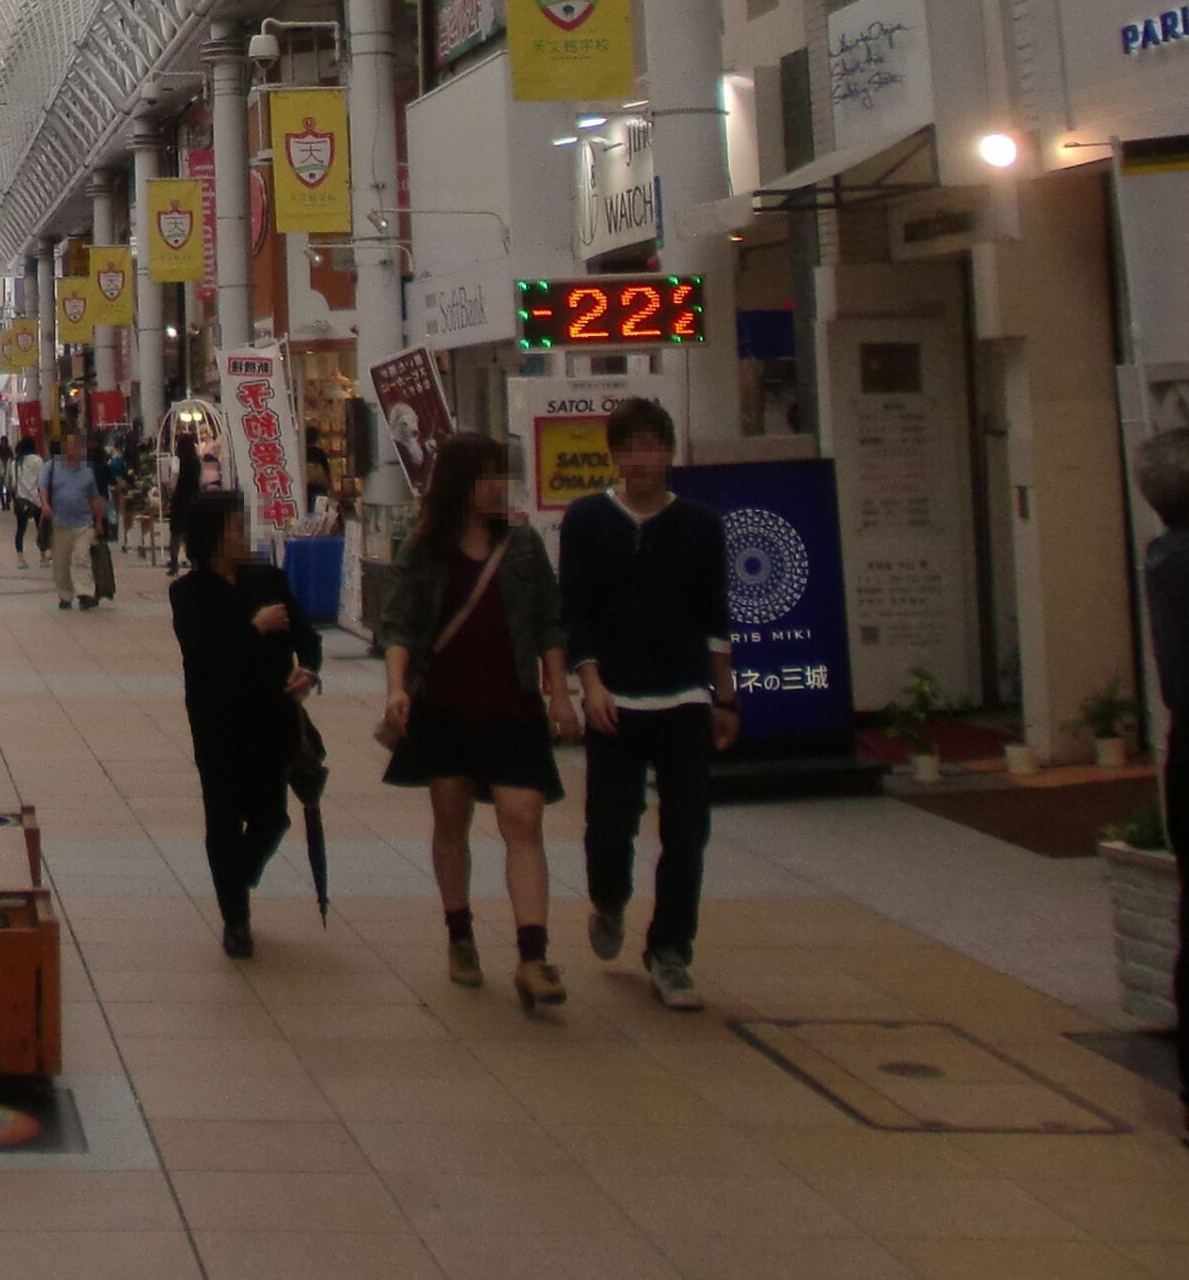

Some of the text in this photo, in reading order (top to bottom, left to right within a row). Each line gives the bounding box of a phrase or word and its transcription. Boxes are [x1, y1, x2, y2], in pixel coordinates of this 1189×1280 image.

[604, 183, 653, 234] WATCH
[439, 283, 488, 334] SoftBank
[547, 399, 595, 413] SATOL
[729, 629, 812, 643] RIS MIKI
[728, 664, 829, 694] ネの三城
